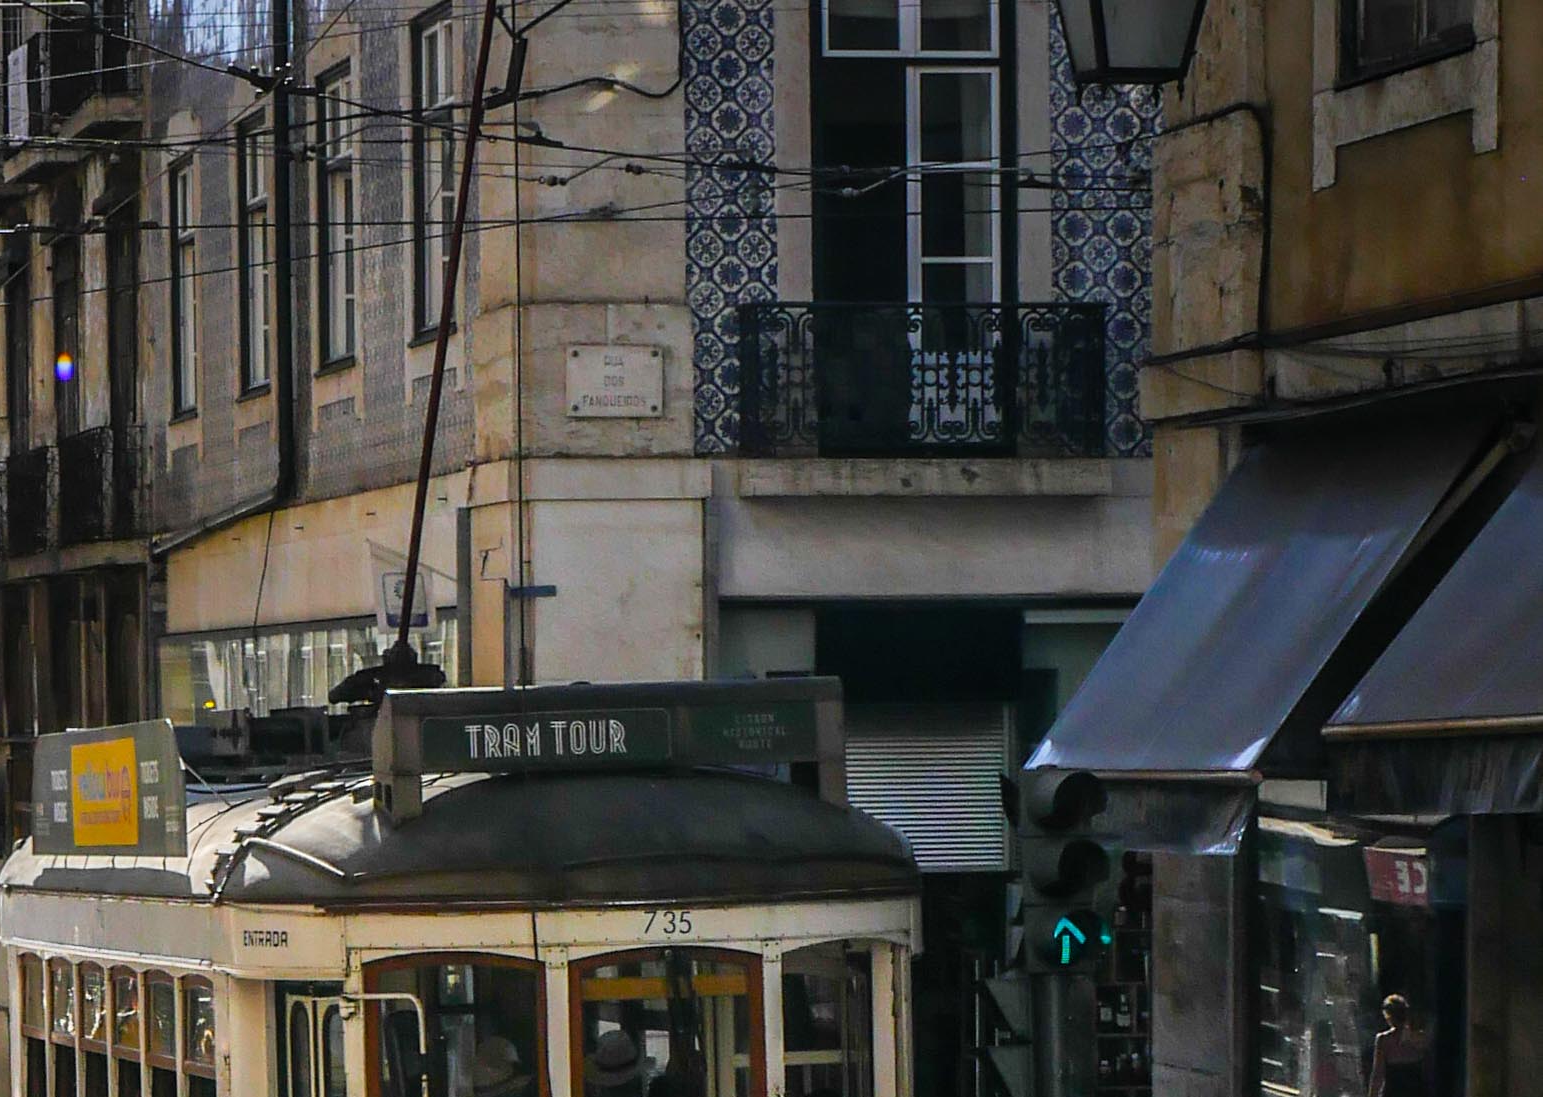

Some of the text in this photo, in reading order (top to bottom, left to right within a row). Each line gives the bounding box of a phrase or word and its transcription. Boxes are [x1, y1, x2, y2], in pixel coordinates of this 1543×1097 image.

[603, 375, 625, 387] DOS
[464, 718, 627, 759] TRAM TOUR
[644, 911, 691, 934] 735
[243, 930, 288, 947] ENTRADA
